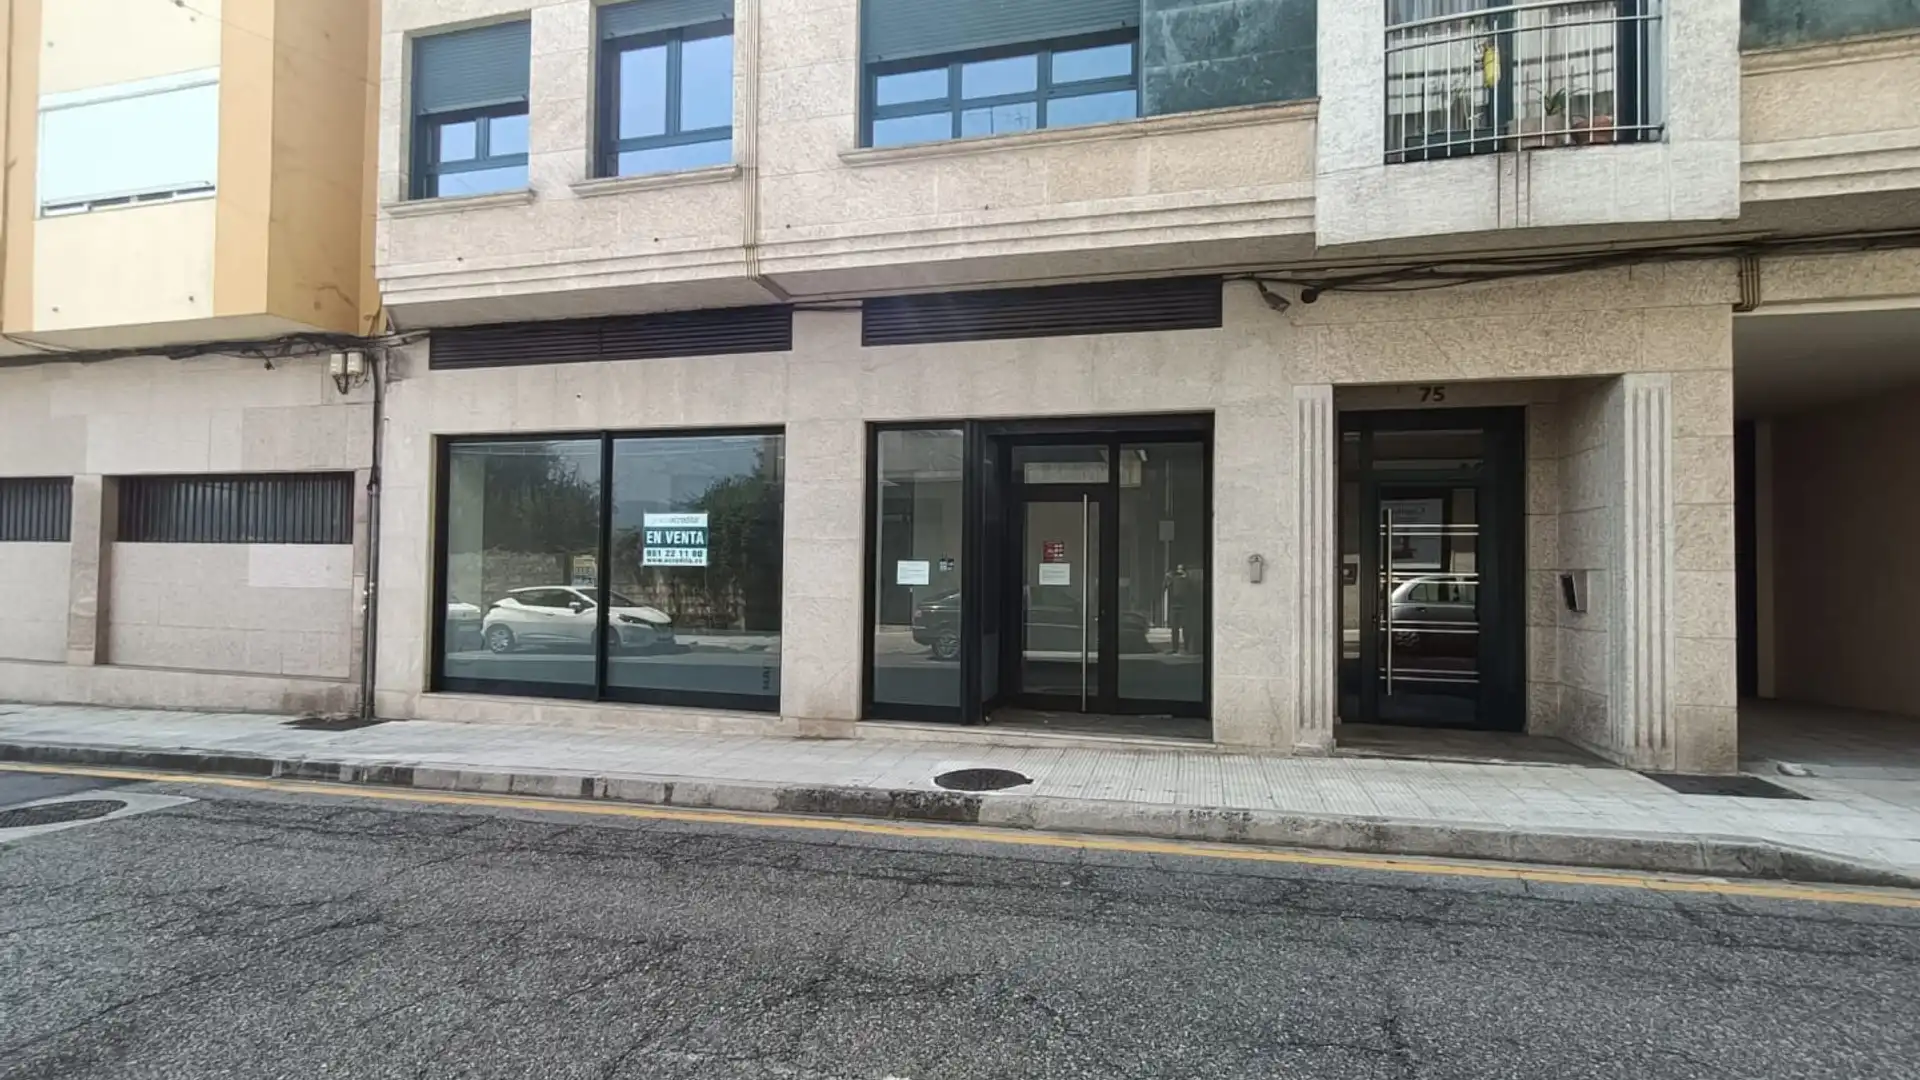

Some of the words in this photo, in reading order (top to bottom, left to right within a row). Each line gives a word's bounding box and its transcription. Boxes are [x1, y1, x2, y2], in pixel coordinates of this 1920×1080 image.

[1419, 386, 1446, 402] 75
[647, 530, 661, 544] EN
[665, 530, 704, 545] VENTA
[665, 549, 675, 557] 22
[679, 549, 688, 557] 11
